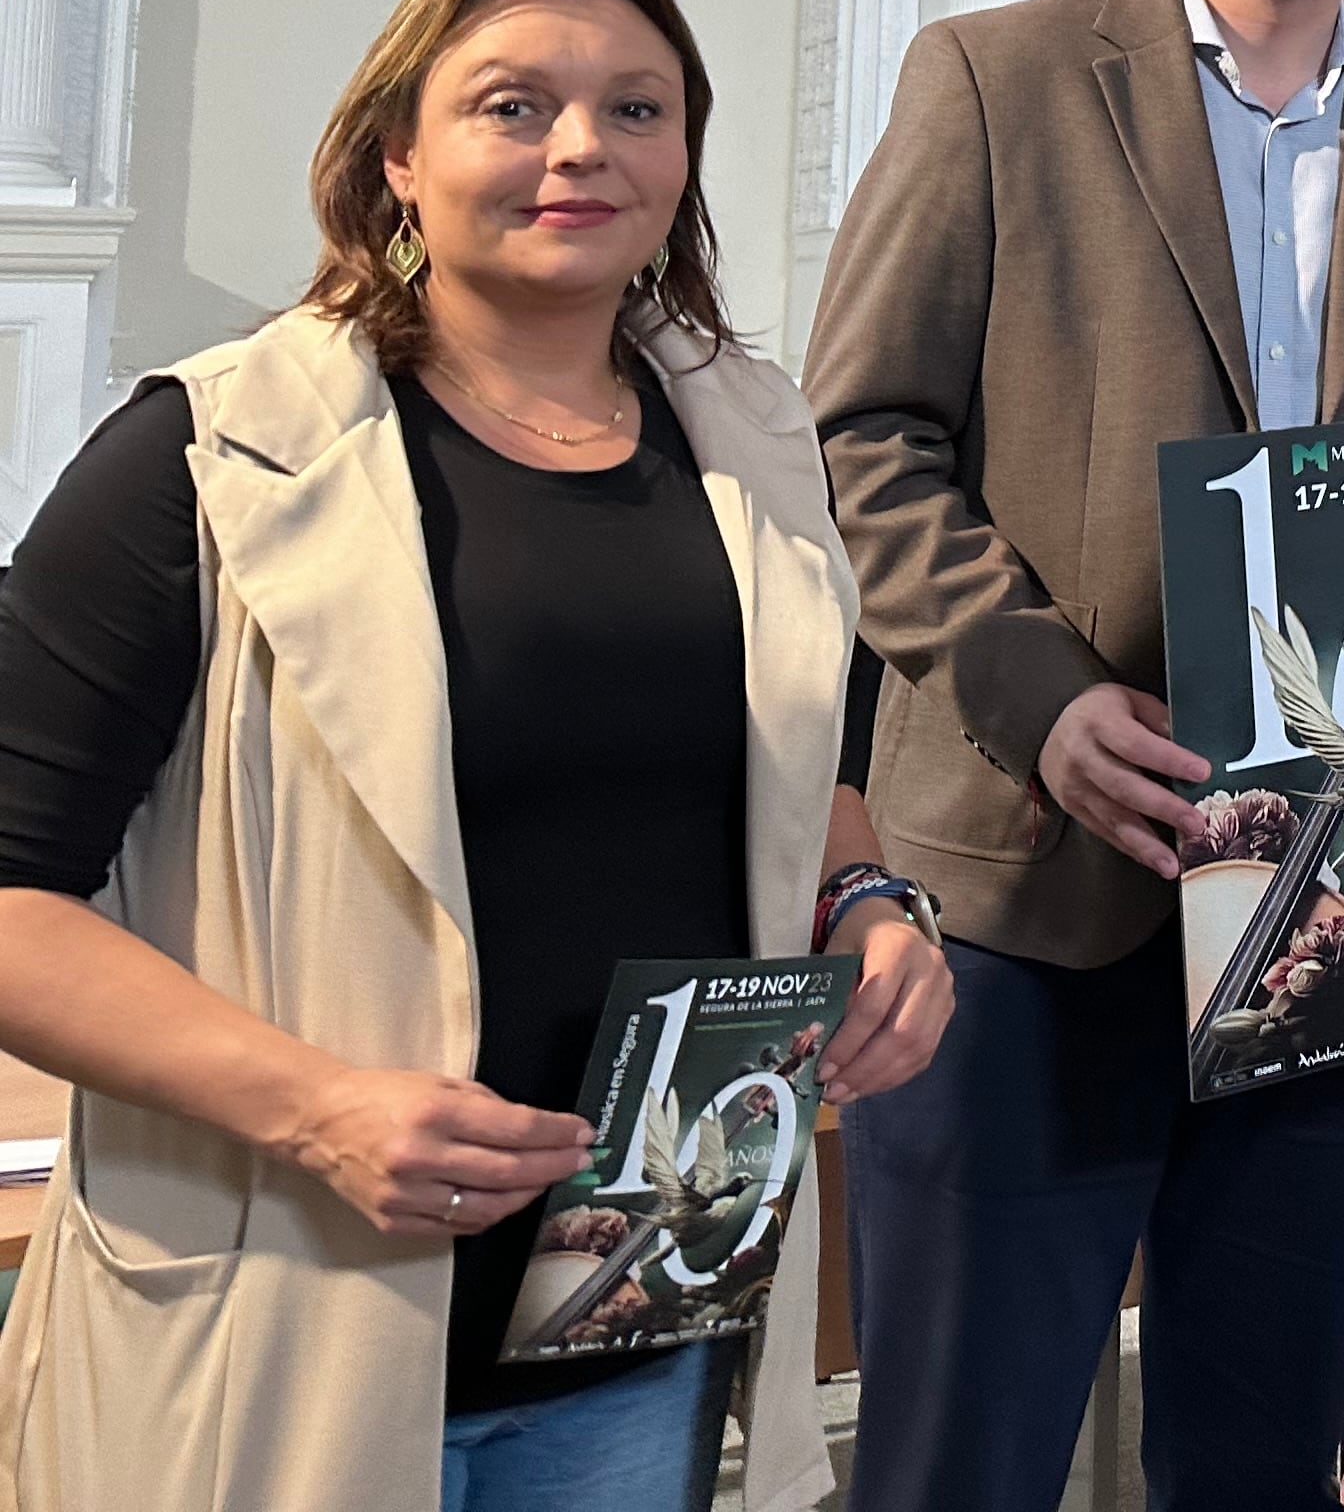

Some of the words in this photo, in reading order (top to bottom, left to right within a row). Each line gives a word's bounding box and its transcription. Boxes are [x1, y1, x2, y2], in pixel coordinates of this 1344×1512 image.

[706, 977, 761, 1000] 17-19
[762, 973, 809, 996] NOV
[808, 972, 833, 994] 23
[613, 1013, 640, 1068] Segura
[610, 1068, 625, 1088] en
